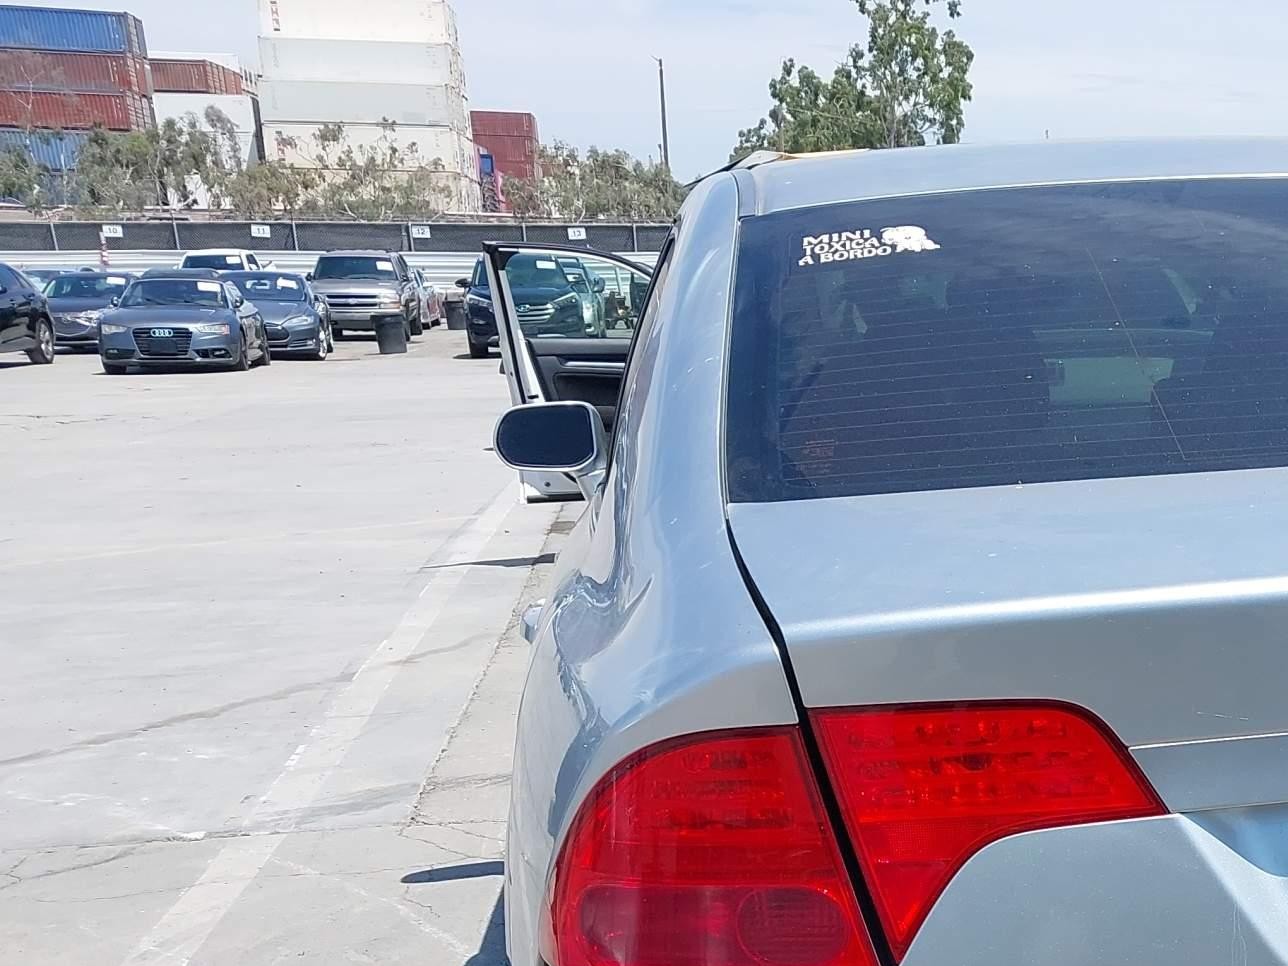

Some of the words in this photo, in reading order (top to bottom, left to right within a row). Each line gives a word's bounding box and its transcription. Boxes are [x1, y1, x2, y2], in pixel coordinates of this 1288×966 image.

[802, 229, 871, 247] MINI
[802, 236, 881, 256] TOXICA
[797, 255, 815, 266] A
[819, 245, 892, 264] BORDO
